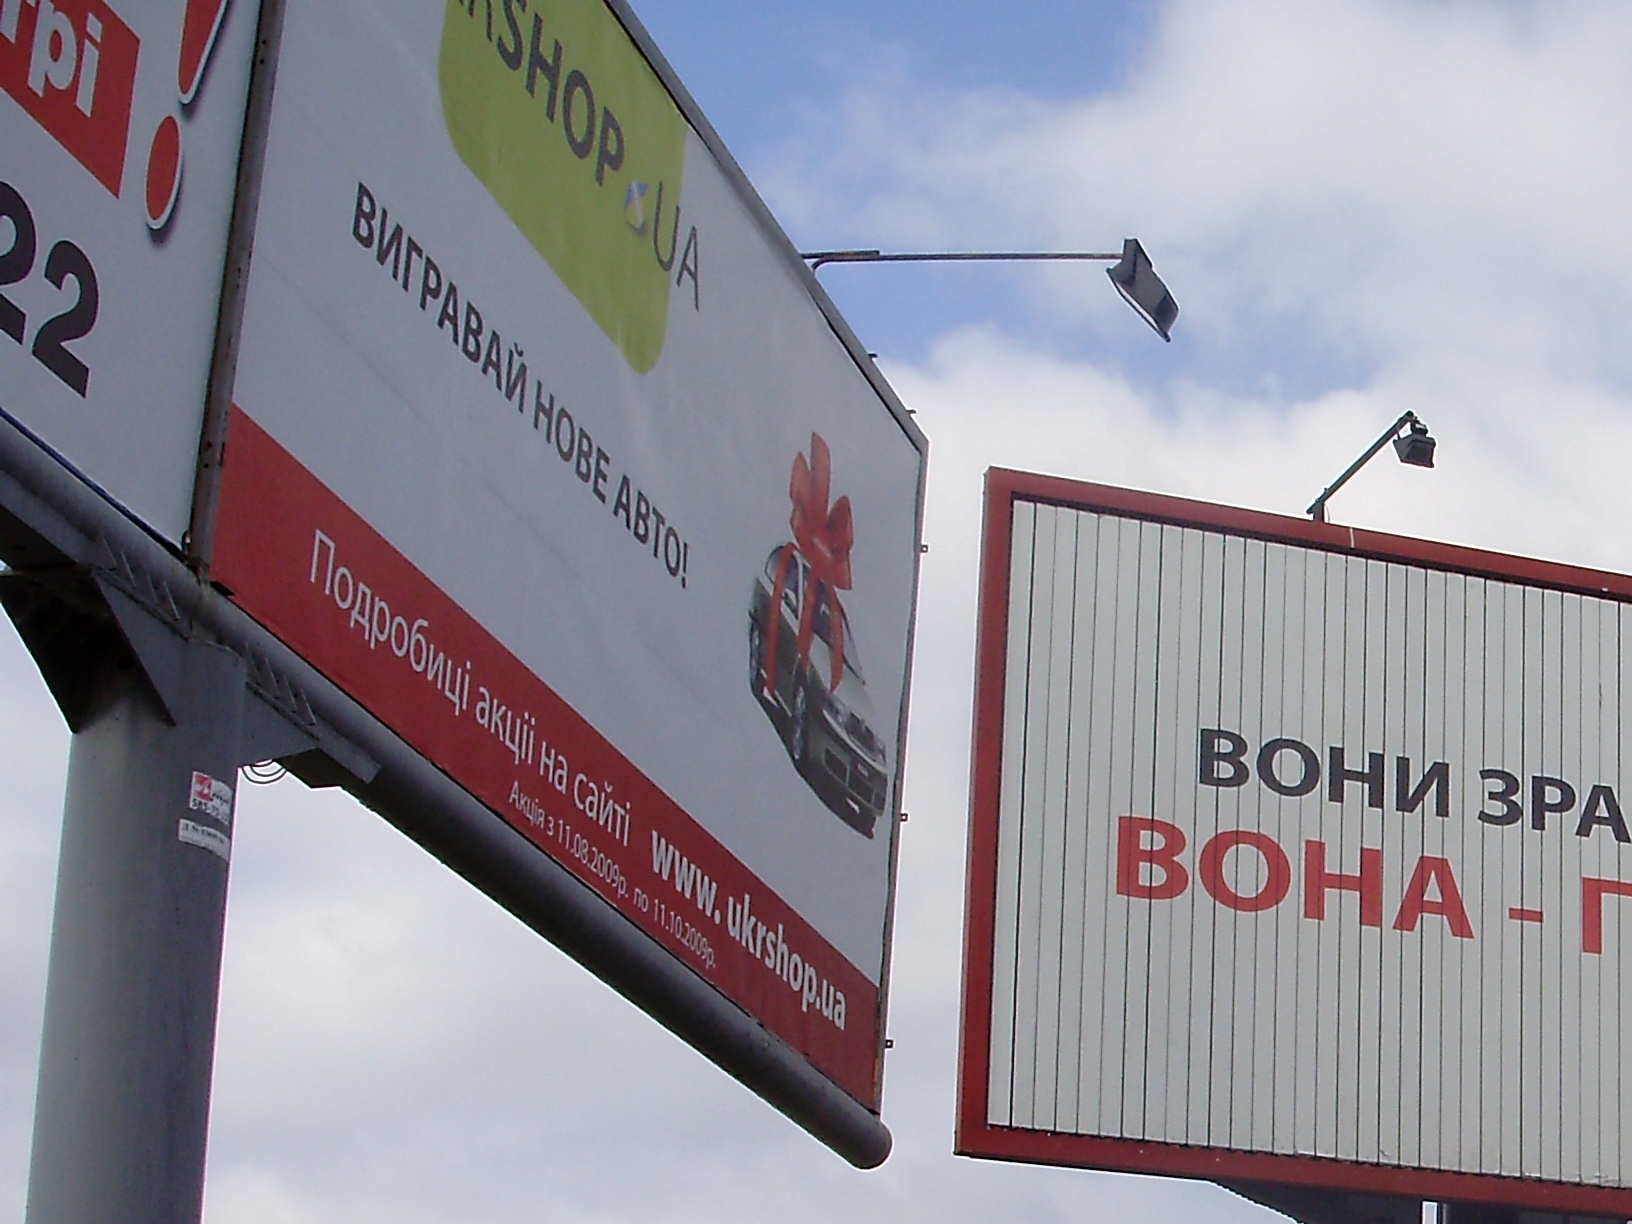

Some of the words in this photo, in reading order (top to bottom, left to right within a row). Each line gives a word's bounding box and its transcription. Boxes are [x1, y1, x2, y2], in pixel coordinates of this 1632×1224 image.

[468, 0, 626, 187] SHOP
[352, 181, 528, 414] ВИГРАВАЙ
[533, 379, 611, 504] НОВЕ
[613, 474, 689, 589] АВТО!
[310, 528, 472, 716] Подробиці
[540, 741, 569, 794] на
[573, 774, 632, 846] сайті
[727, 893, 847, 1031] ukrshop.ua
[1199, 728, 1450, 818] ВОНИ
[509, 781, 546, 828] Акція
[558, 819, 629, 899] 11.08.2009р.
[633, 888, 650, 913] по
[653, 899, 717, 969] 11.10.2009р.
[1115, 815, 1474, 940] ВОНА
